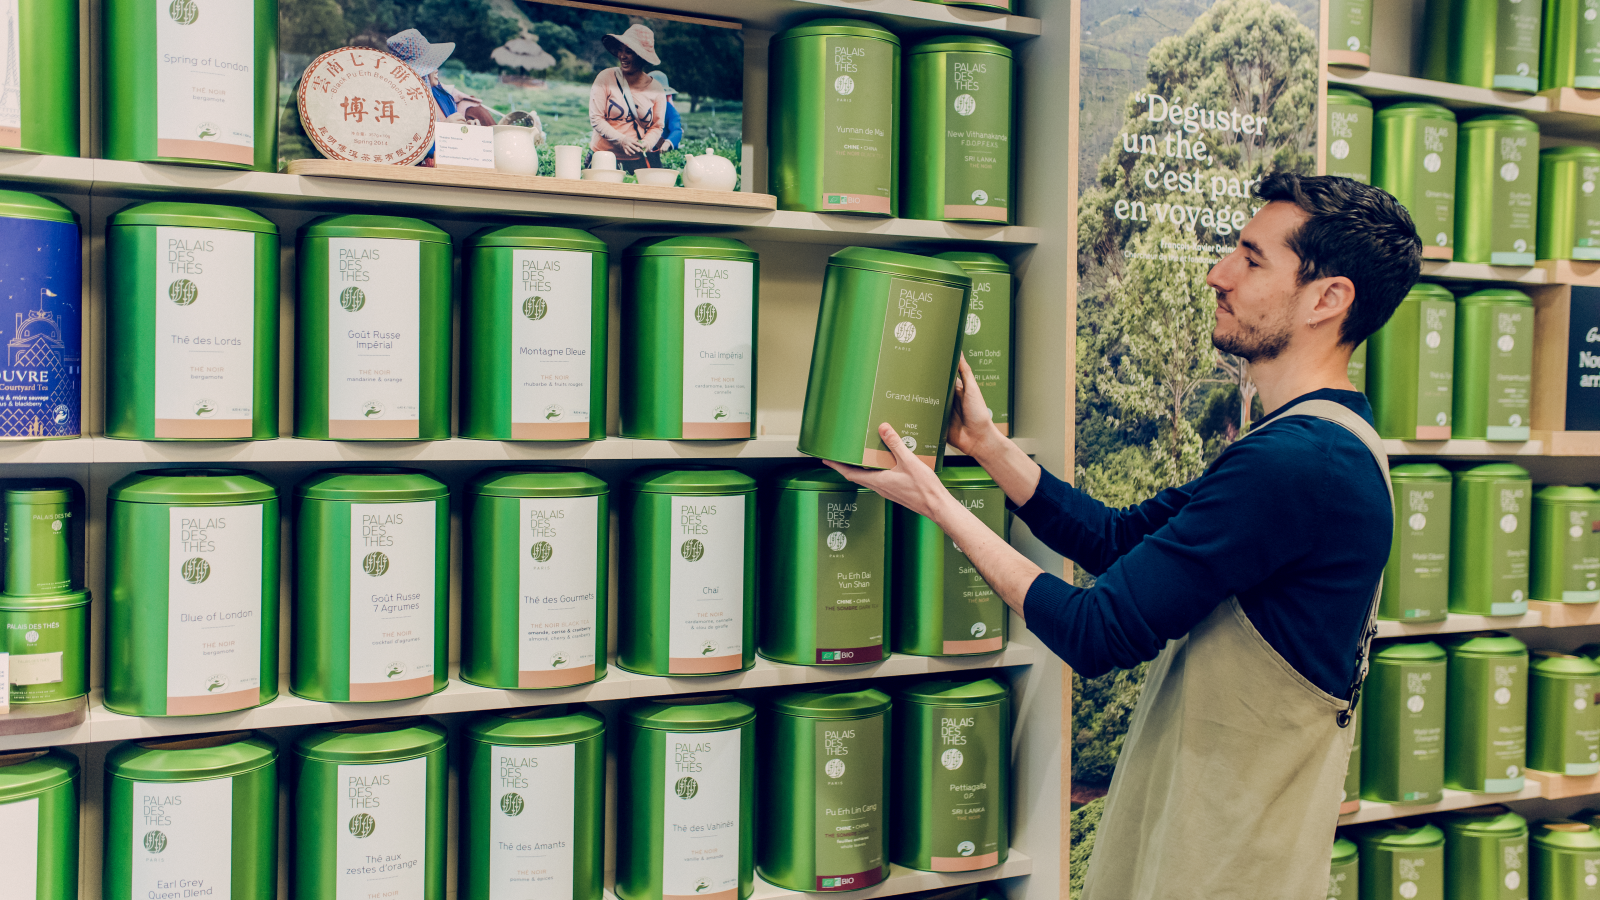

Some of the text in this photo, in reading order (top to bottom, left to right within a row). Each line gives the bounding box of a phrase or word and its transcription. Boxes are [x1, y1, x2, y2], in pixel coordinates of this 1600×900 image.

[835, 47, 865, 56] PALAIS
[164, 54, 250, 72] Spring of London
[835, 55, 852, 64] DES
[955, 63, 986, 74] PALAIS
[346, 72, 358, 80] Pu
[358, 70, 372, 78] Erh
[955, 72, 974, 82] DES
[836, 126, 864, 134] Yunnan
[966, 131, 1007, 142] Vithanakande
[354, 138, 373, 146] Spring
[1122, 130, 1213, 166] un thé,
[1114, 199, 1246, 235] en voyage
[168, 239, 214, 252] PALAIS
[168, 251, 194, 262] DES
[340, 249, 380, 260] PALAIS
[340, 260, 362, 271] DES
[522, 260, 560, 271] PALAIS
[522, 271, 545, 281] DES
[695, 269, 728, 280] PALAIS
[695, 279, 715, 288] DES
[900, 289, 932, 302] PALAIS
[898, 298, 918, 309] DES
[348, 330, 401, 340] Goût Russe
[171, 335, 242, 346] Thé des Lords
[357, 341, 393, 350] Impérial
[520, 347, 586, 357] Montagne Bleue
[0, 370, 48, 382] UVRE
[886, 390, 940, 406] Grand Himalaya
[681, 505, 717, 515] PALAIS
[828, 503, 858, 512] PALAIS
[362, 514, 403, 526] PALAIS
[530, 510, 564, 520] PALAIS
[681, 515, 702, 525] DES
[827, 512, 845, 520] DES
[181, 518, 226, 529] PALAIS
[530, 520, 550, 528] DES
[181, 530, 207, 542] DES
[362, 525, 386, 537] DES
[371, 593, 420, 603] Goût Russe
[524, 593, 594, 604] Thé des Gourmets
[381, 602, 419, 613] Agrumes
[181, 610, 253, 622] Blue of London
[942, 717, 974, 727] PALAIS
[825, 730, 855, 739] PALAIS
[942, 726, 961, 736] DES
[675, 742, 711, 752] PALAIS
[825, 738, 843, 748] DES
[500, 757, 538, 768] PALAIS
[675, 753, 696, 762] DES
[500, 767, 522, 778] DES
[349, 775, 390, 787] PALAIS
[349, 787, 372, 798] DES
[143, 796, 182, 805] PALAIS
[143, 806, 164, 816] DES
[863, 804, 877, 814] Cang
[673, 824, 687, 832] Thé
[690, 824, 704, 832] des
[499, 841, 565, 851] Thé des Amants
[366, 853, 401, 863] Thé aux
[346, 859, 417, 875] zestes d'orange
[157, 878, 204, 889] Earl Grey
[148, 886, 213, 900] Queen Blend
